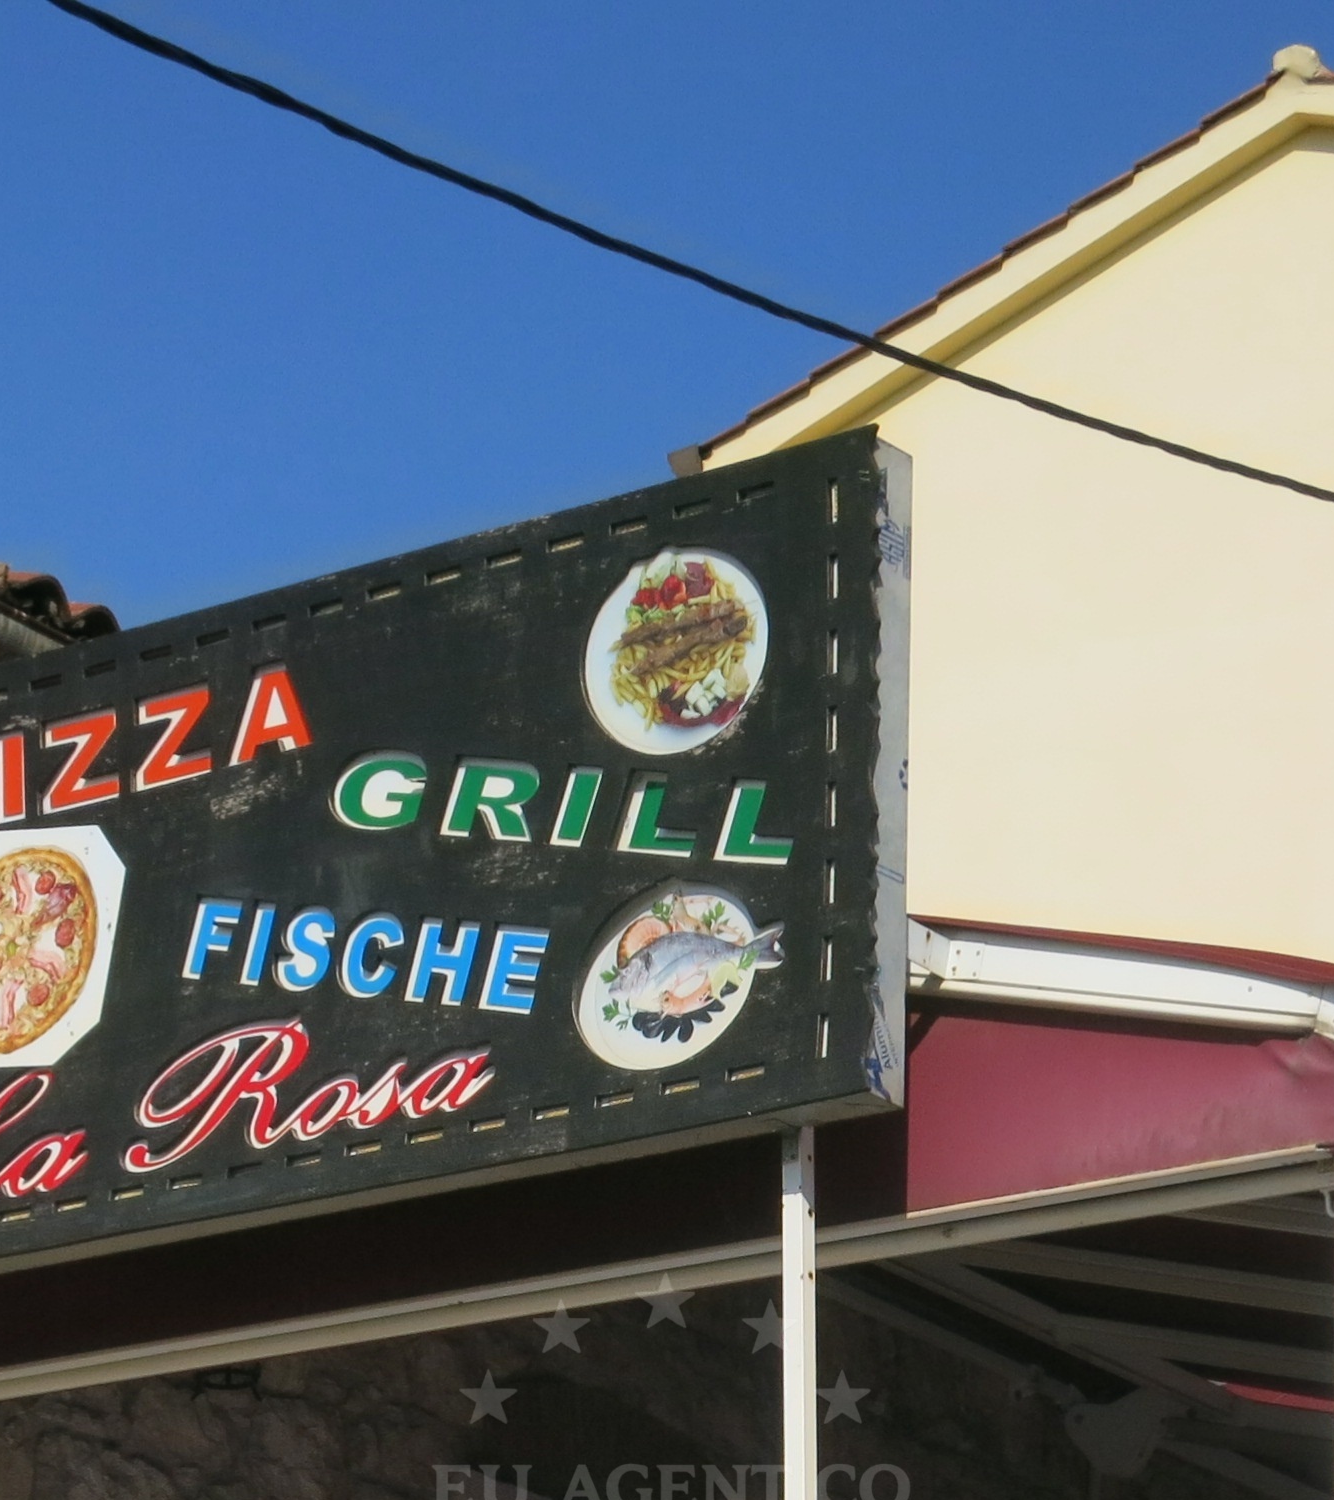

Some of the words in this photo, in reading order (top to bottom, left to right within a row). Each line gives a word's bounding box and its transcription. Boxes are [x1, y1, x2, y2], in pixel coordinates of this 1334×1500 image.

[332, 752, 794, 865] GRILL
[181, 897, 551, 1014] FISCHE
[122, 1015, 497, 1174] Rosa
